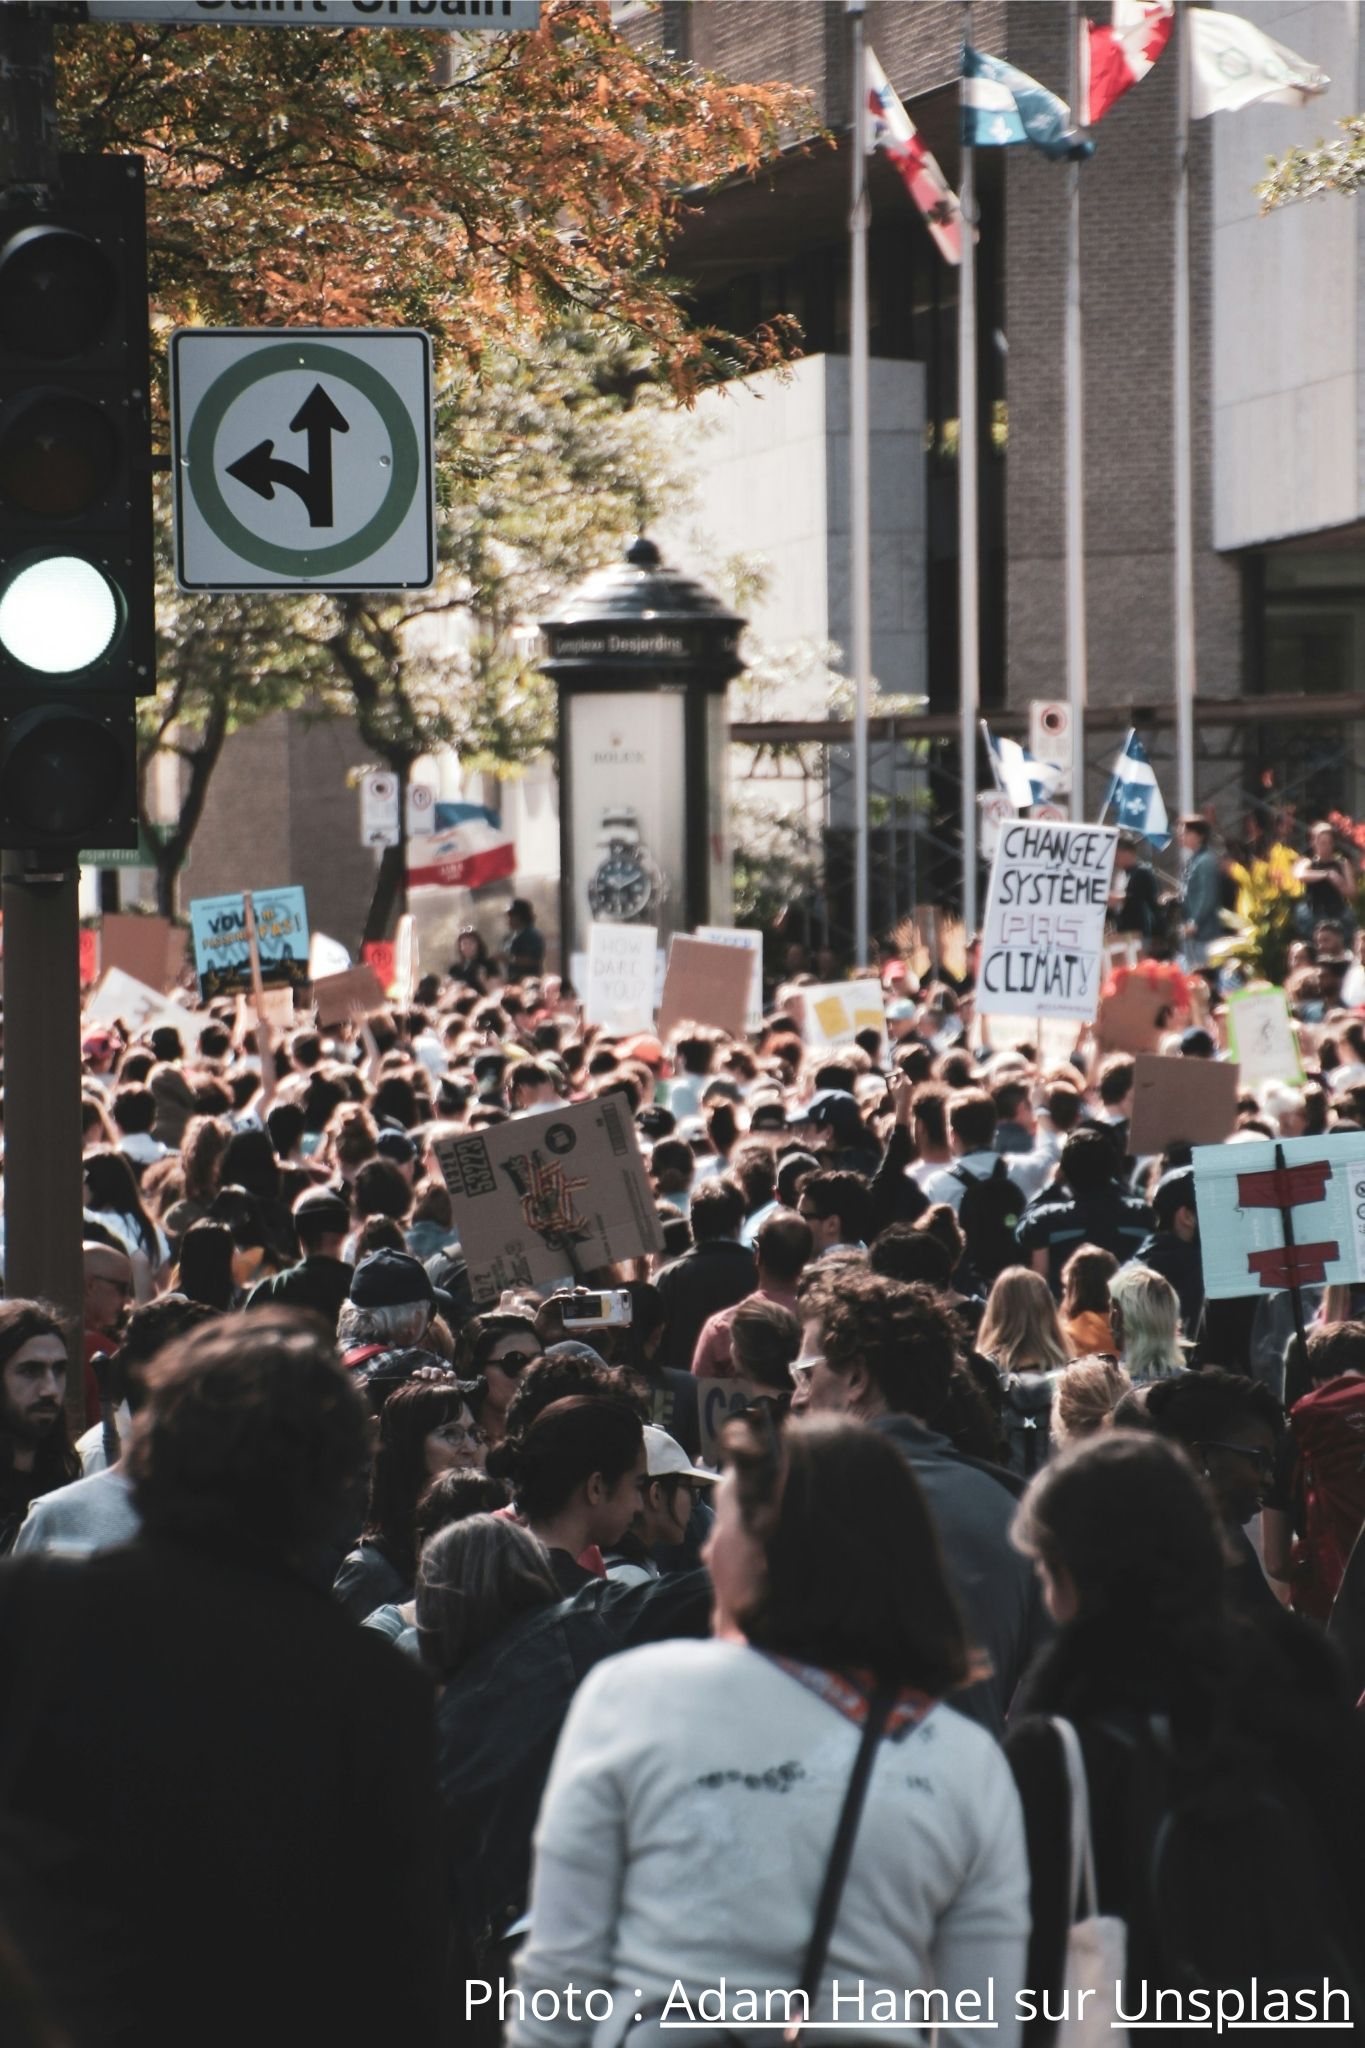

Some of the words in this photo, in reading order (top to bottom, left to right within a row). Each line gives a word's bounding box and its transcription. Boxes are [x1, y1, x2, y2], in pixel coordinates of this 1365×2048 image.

[608, 634, 684, 655] Desjardins
[1005, 827, 1116, 870] CHANGEZ
[999, 868, 1109, 906] SYSTÈME
[602, 936, 642, 955] HOW
[1000, 912, 1085, 951] PAS
[594, 957, 641, 977] DARE
[984, 951, 1098, 999] CLIMAT!
[456, 1138, 494, 1195] 53223
